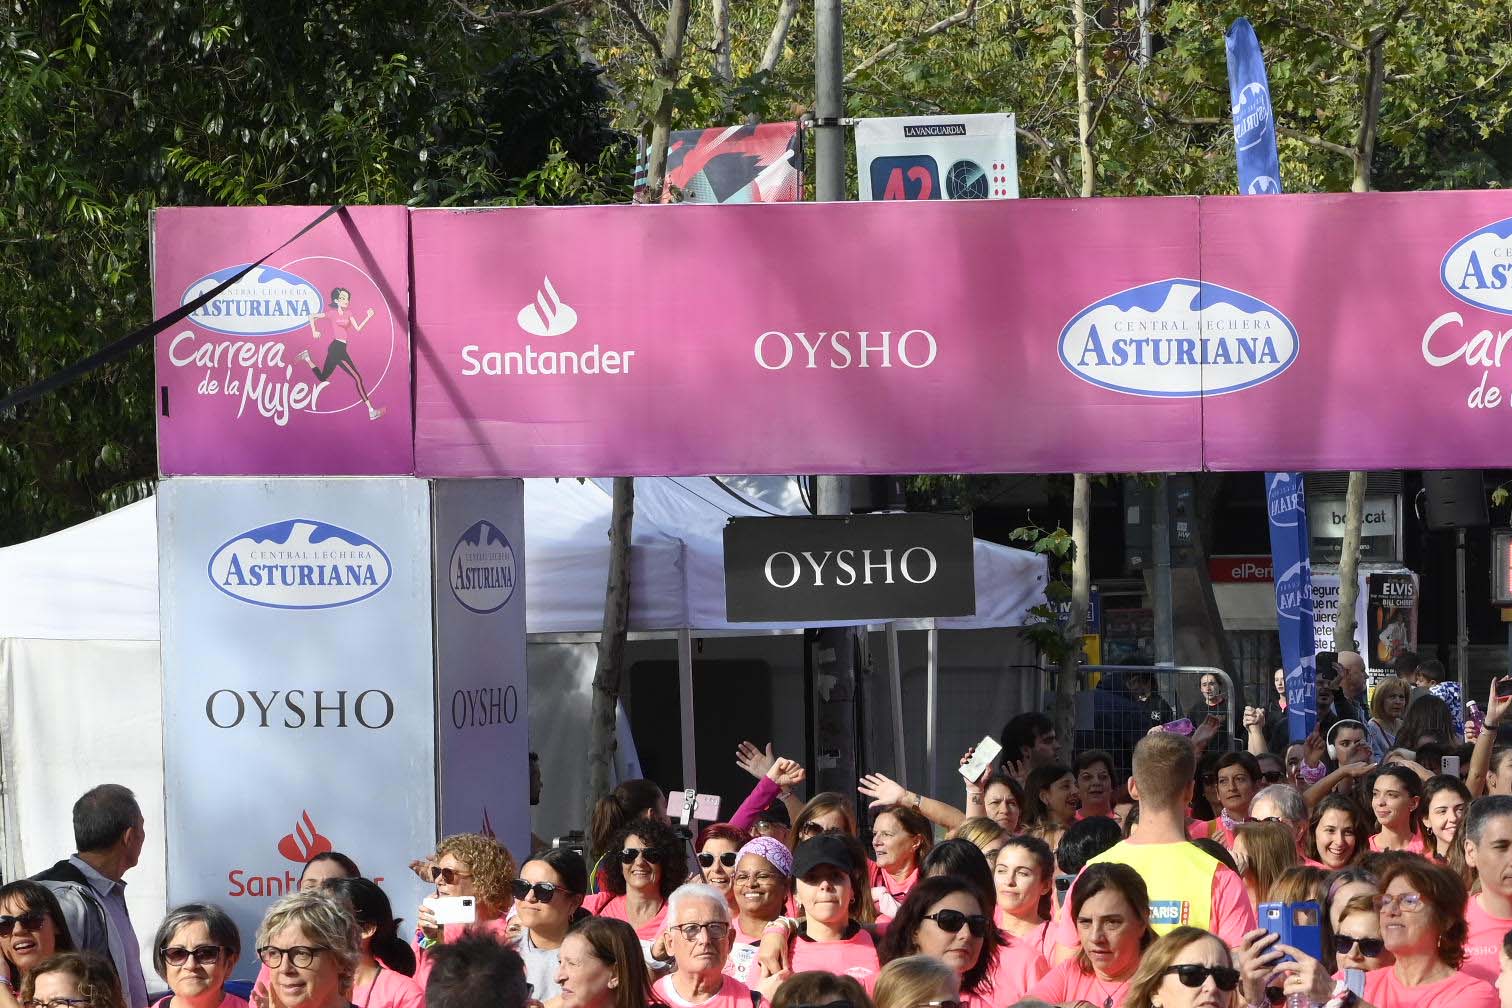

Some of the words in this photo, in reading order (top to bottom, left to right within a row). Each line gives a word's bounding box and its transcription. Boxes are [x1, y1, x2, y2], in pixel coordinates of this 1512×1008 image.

[905, 127, 917, 136] LA
[1114, 318, 1188, 332] CENTRAL
[1196, 318, 1271, 331] LECHERA
[169, 331, 286, 369] Carrera
[462, 345, 635, 377] Santander
[755, 329, 937, 370] OYSHO
[1077, 323, 1281, 367] ASTURIANA
[198, 372, 219, 397] de
[225, 371, 240, 397] la
[237, 364, 331, 426] Mujer
[1468, 371, 1502, 410] de
[223, 553, 379, 587] ASTURIANA
[251, 550, 308, 560] CENTRAL
[313, 550, 372, 560] LECHERA
[455, 557, 513, 590] ASTURIANA
[764, 547, 937, 589] OYSHO
[1382, 582, 1413, 596] ELVIS
[206, 688, 395, 729] OYSHO
[452, 685, 518, 730] OYSHO
